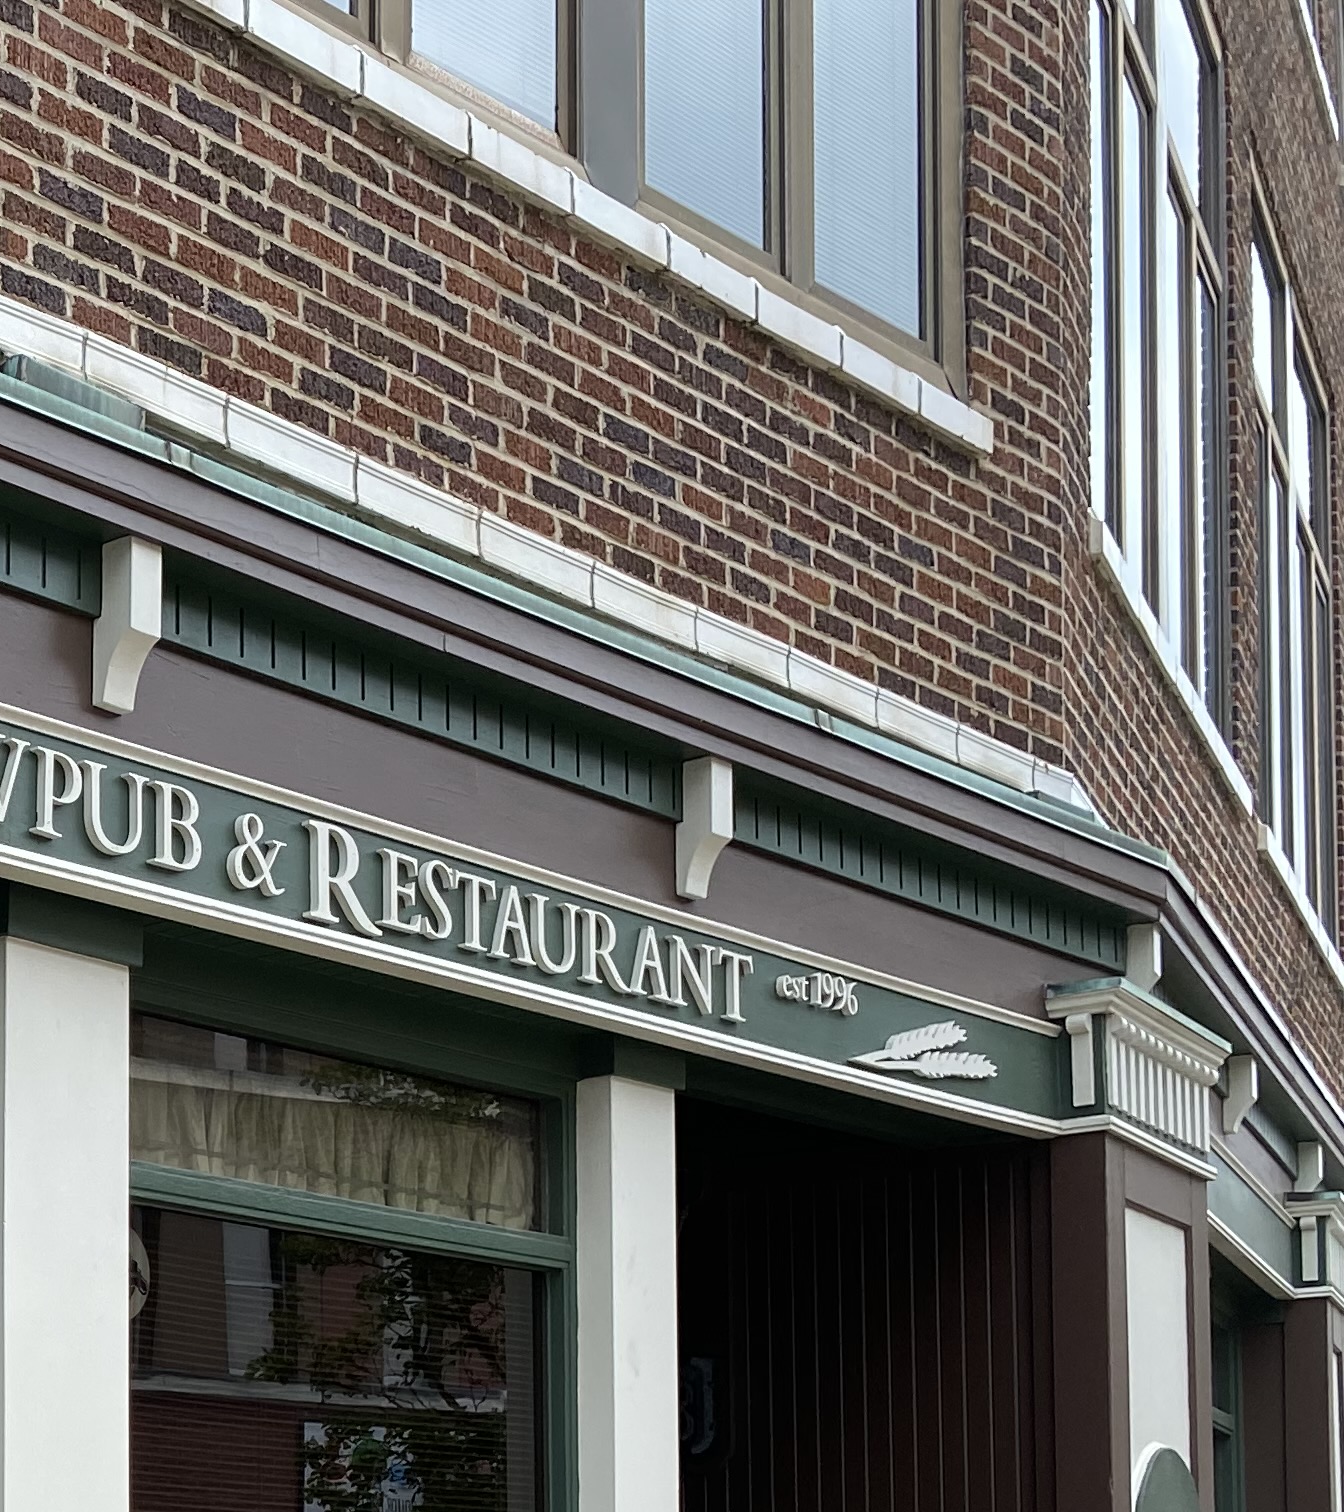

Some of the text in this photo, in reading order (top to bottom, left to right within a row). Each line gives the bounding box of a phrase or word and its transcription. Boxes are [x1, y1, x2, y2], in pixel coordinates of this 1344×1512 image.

[226, 812, 286, 897] &
[302, 820, 754, 1024] RESTAURANT
[776, 973, 859, 1017] est 1996
